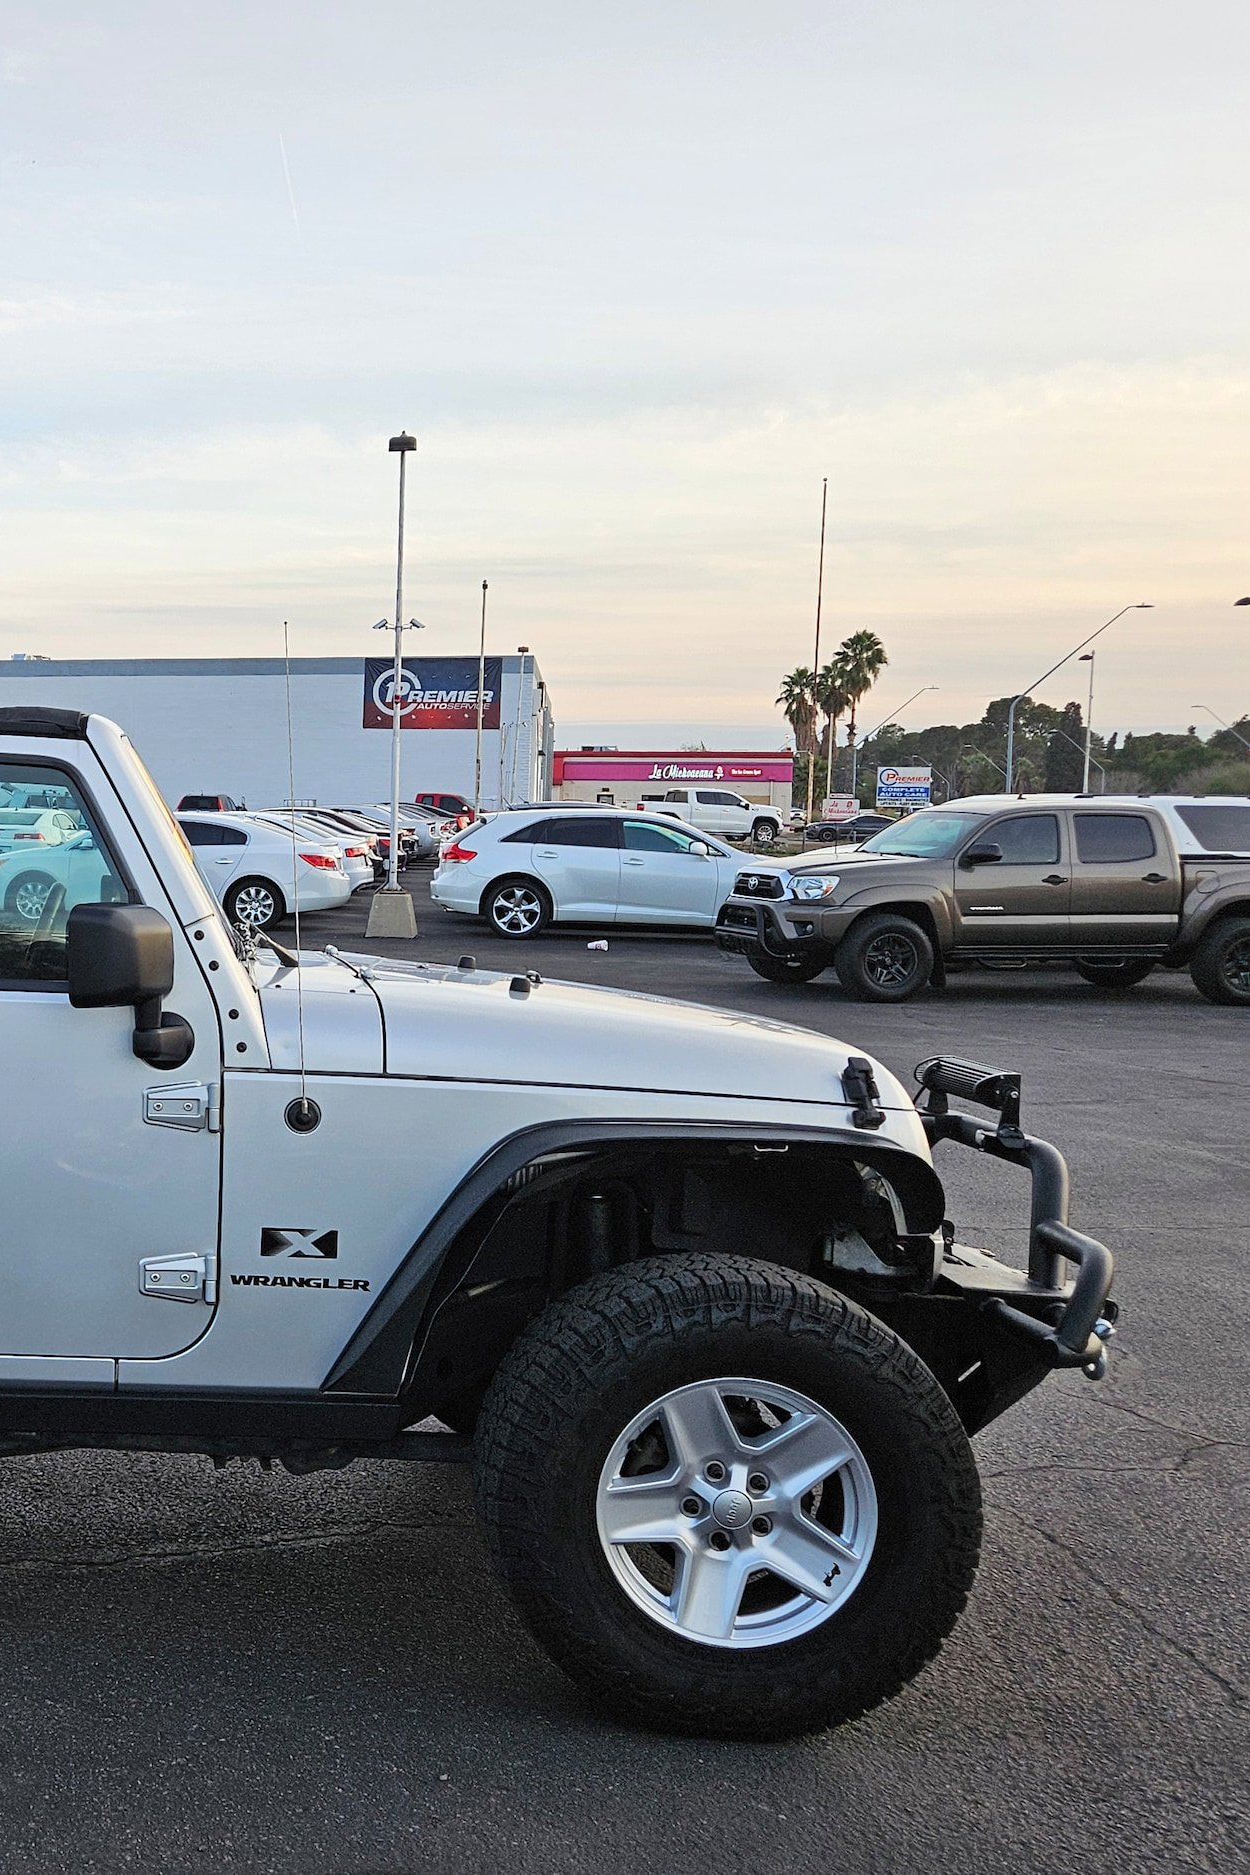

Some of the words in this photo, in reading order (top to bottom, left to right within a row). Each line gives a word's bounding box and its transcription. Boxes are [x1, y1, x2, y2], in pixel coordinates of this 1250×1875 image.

[648, 763, 662, 779] La
[886, 773, 931, 783] PREMIER
[230, 1274, 371, 1292] WRANGLER
